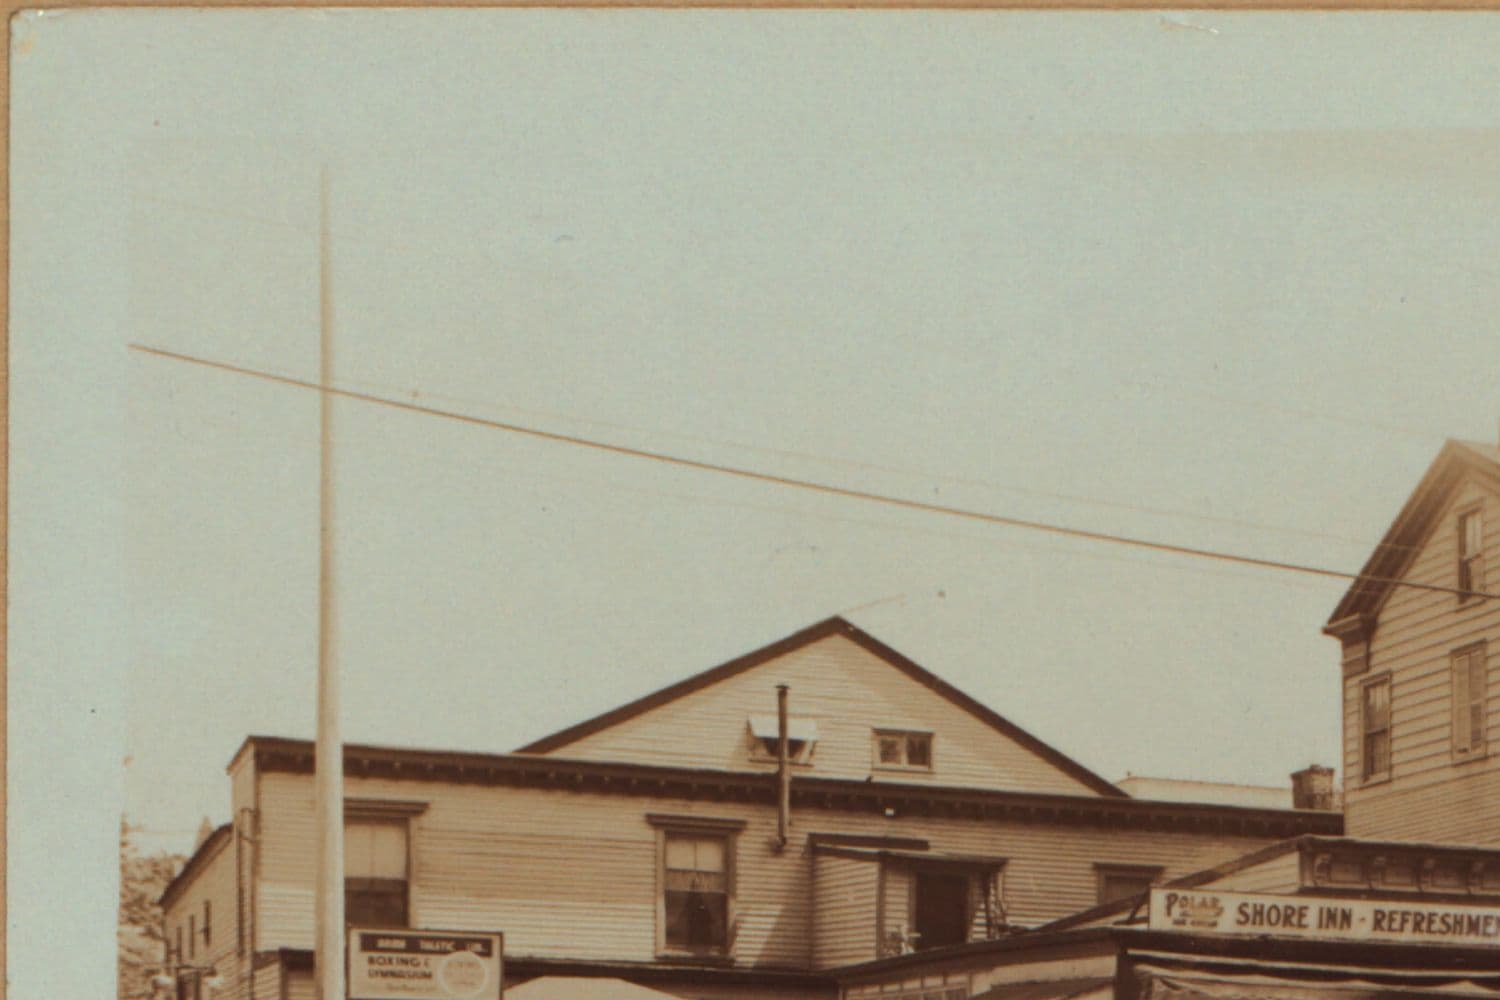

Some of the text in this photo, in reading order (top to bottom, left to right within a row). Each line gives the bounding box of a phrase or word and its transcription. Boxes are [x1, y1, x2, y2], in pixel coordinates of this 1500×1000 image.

[1235, 902, 1309, 929] SHORE
[1316, 906, 1352, 930] INN
[368, 955, 421, 968] BOXING
